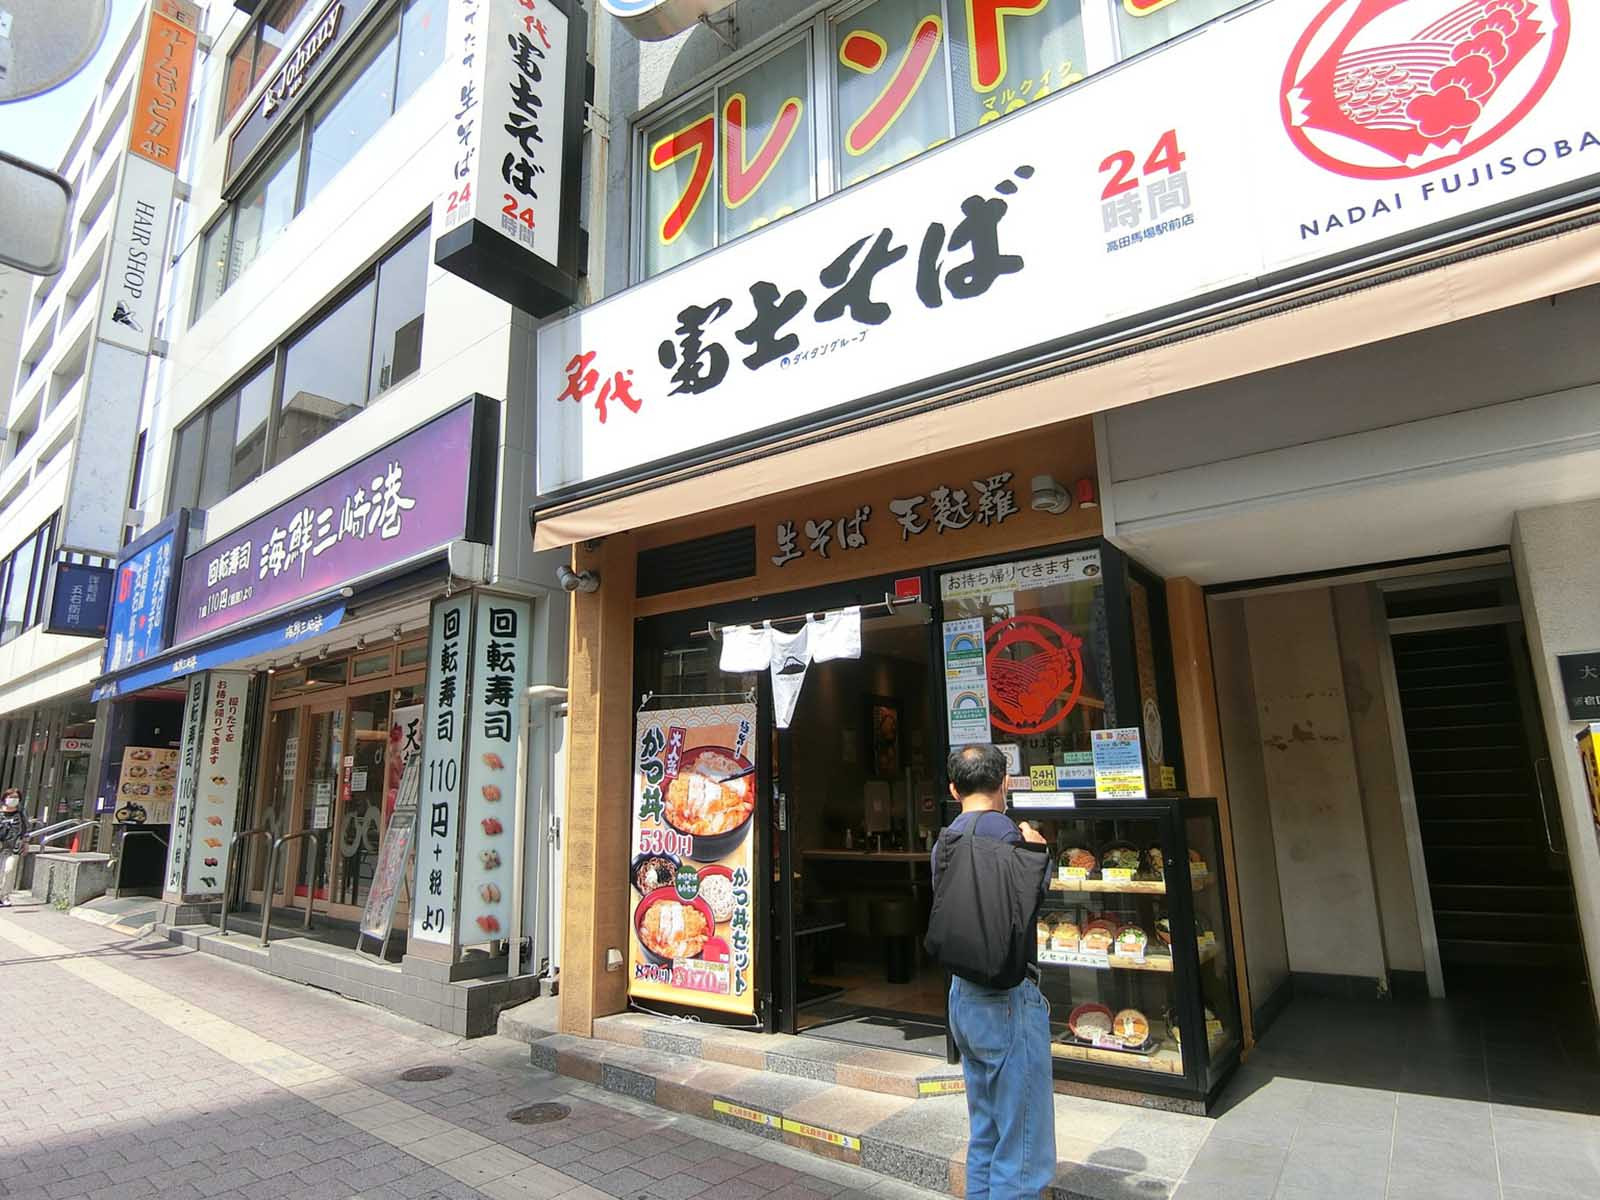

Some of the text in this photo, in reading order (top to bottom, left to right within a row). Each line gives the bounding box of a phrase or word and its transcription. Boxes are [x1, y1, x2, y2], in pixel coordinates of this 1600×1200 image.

[1098, 129, 1186, 201] 24
[1299, 130, 1600, 241] NADAI FUJISOBA
[446, 182, 472, 214] 24
[502, 193, 536, 230] 24
[1102, 171, 1192, 234] 時間
[123, 200, 156, 300] HAIR SHOP
[501, 214, 535, 249] 時間
[1105, 212, 1195, 254] 高田馬場駅前店
[793, 329, 869, 366] ダイタングループ
[556, 350, 643, 425] 名代
[259, 461, 417, 579] 海鮮三崎港
[771, 504, 872, 566] 生そば
[947, 556, 1074, 591] お持ち帰りできます
[437, 607, 460, 743] 回転寿司
[483, 607, 518, 744] 回転寿司
[638, 726, 667, 825] かつ丼
[1031, 768, 1054, 779] 24H
[1032, 779, 1055, 787] OPEN
[639, 829, 693, 857] 530円
[732, 867, 751, 995] かつ丼セット
